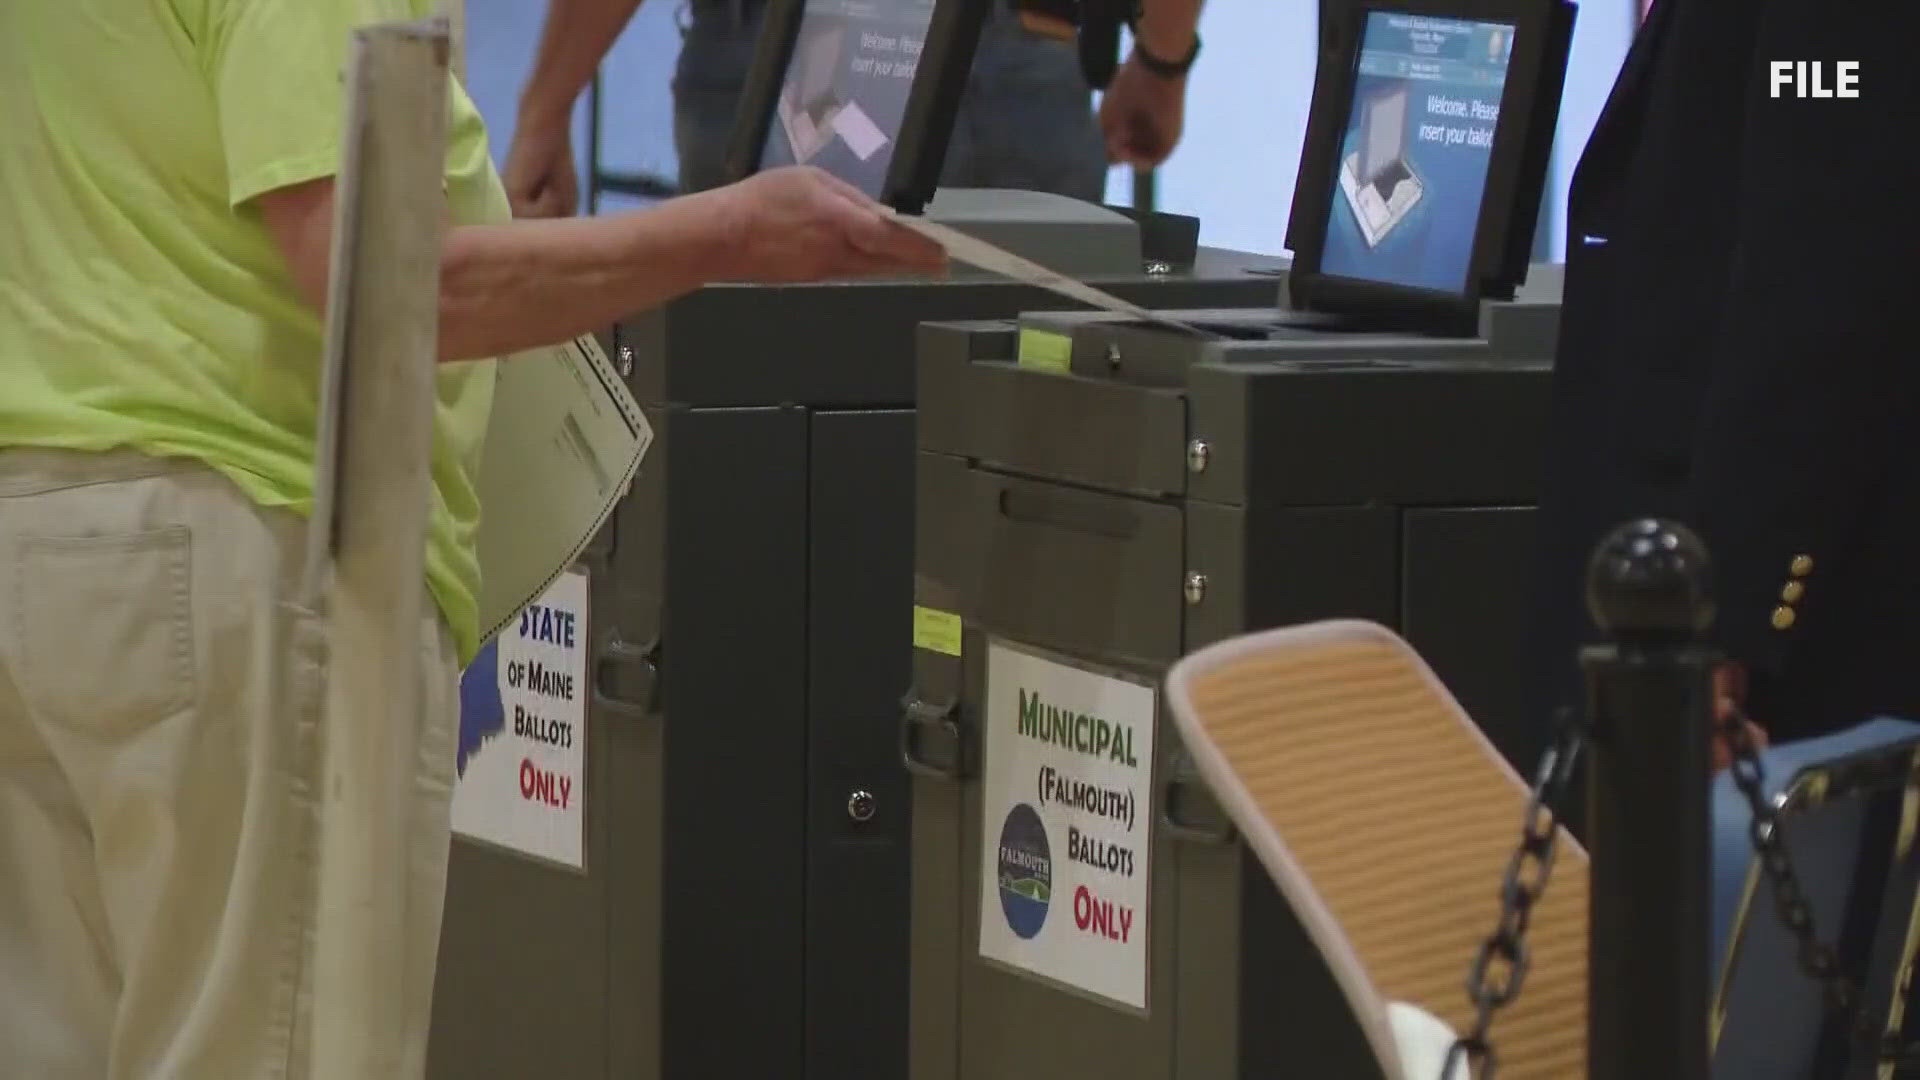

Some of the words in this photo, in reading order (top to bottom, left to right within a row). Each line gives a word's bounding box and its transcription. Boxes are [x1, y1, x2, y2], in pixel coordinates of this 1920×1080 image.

[1419, 123, 1445, 141] insert
[1444, 127, 1467, 146] your
[507, 660, 525, 688] OF
[528, 660, 573, 700] MAINE
[515, 704, 572, 749] BALLOTS
[1018, 687, 1137, 767] MUNICIPAL
[519, 757, 571, 809] ONLY
[1038, 765, 1136, 832] (FALMOUTH)
[1068, 826, 1134, 878] BALLOTS
[1073, 885, 1133, 944] ONLY
